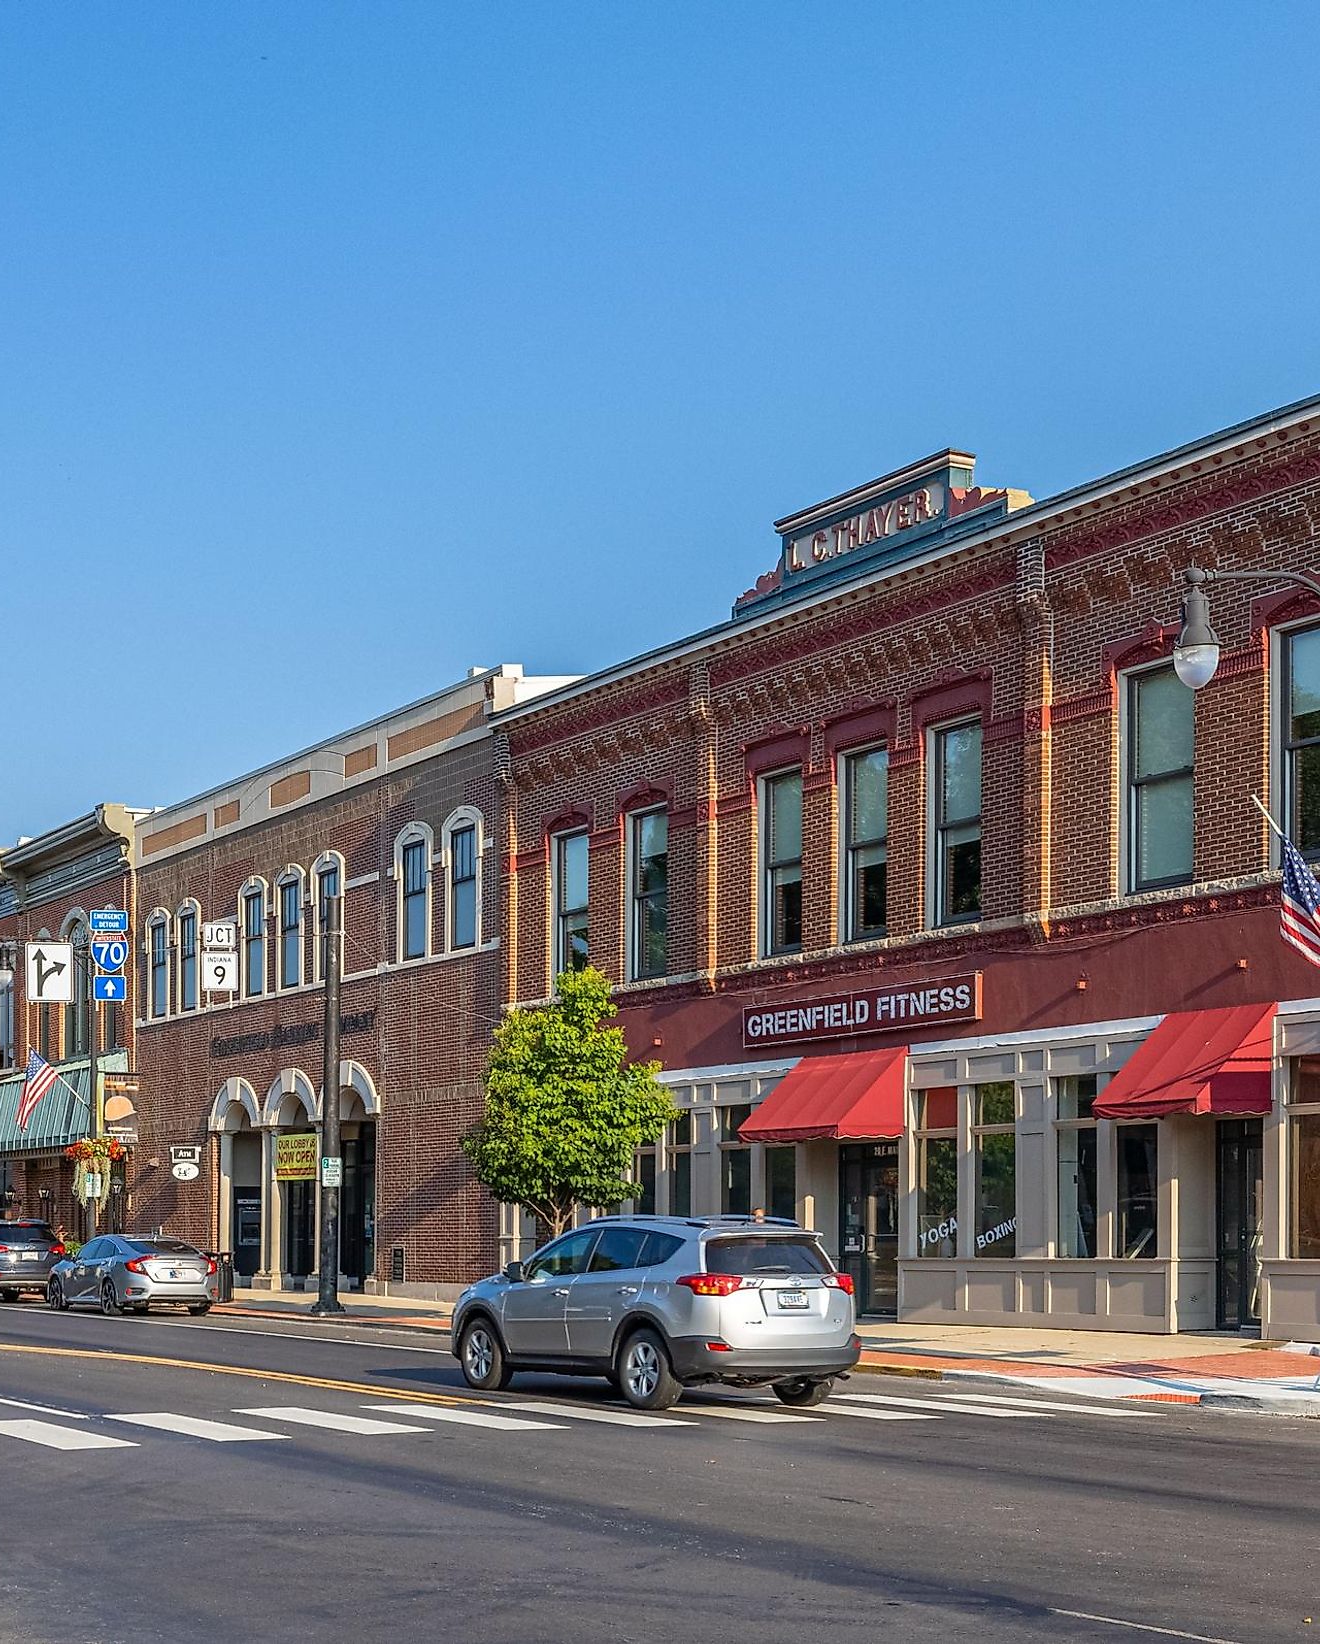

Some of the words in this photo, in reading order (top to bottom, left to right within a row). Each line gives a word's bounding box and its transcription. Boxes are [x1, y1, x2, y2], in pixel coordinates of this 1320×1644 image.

[206, 927, 232, 943] JCT
[95, 942, 125, 965] 70
[213, 965, 226, 985] 9
[747, 1000, 870, 1037] GREENFIELD
[876, 984, 971, 1021] FITNESS
[278, 1151, 295, 1164] NOW
[295, 1150, 316, 1163] OPEN
[919, 1217, 958, 1249] YOGA
